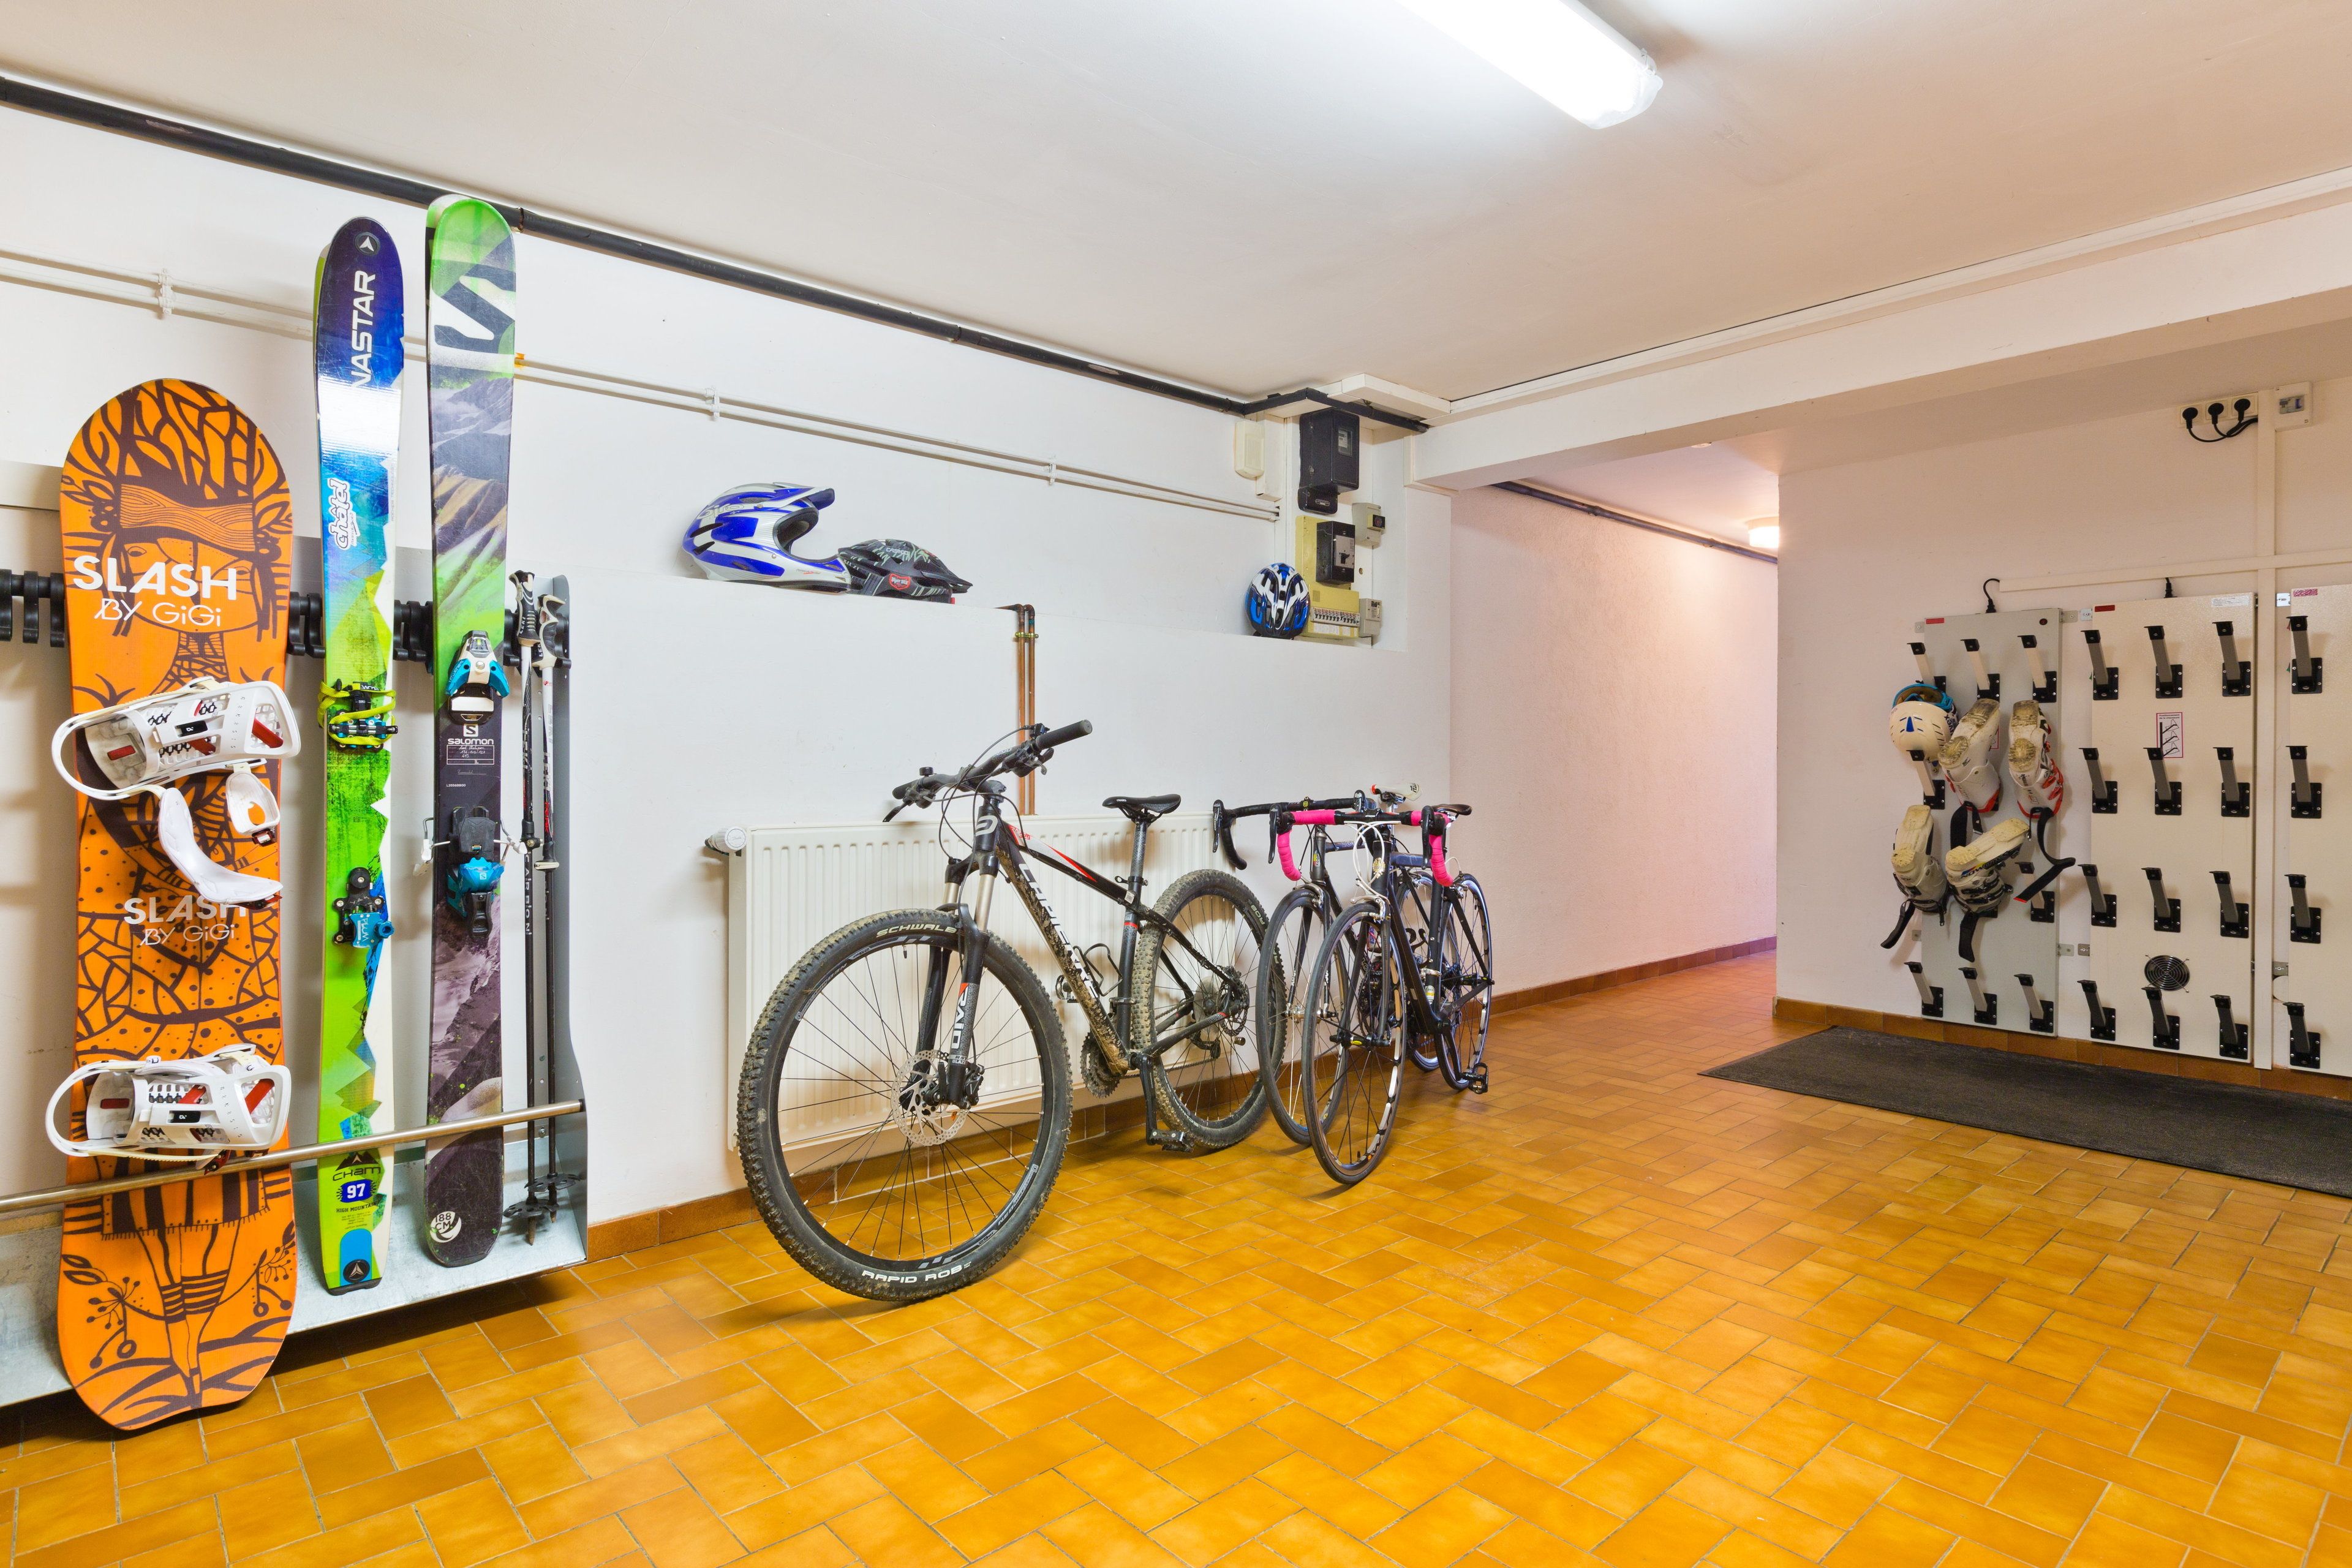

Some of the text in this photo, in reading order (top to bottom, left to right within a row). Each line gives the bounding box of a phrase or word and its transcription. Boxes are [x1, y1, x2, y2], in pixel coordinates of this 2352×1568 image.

[351, 270, 375, 388] NASTAR
[73, 555, 236, 600] SLASH
[94, 598, 142, 621] BY
[140, 927, 176, 946] BY
[876, 924, 957, 938] SCHWALB
[347, 1183, 366, 1199] 97
[350, 1202, 378, 1212] MOUNTAIN
[435, 1213, 451, 1223] 188
[435, 1221, 451, 1230] CM
[861, 1270, 918, 1283] RAPID
[925, 1264, 962, 1281] ROB
